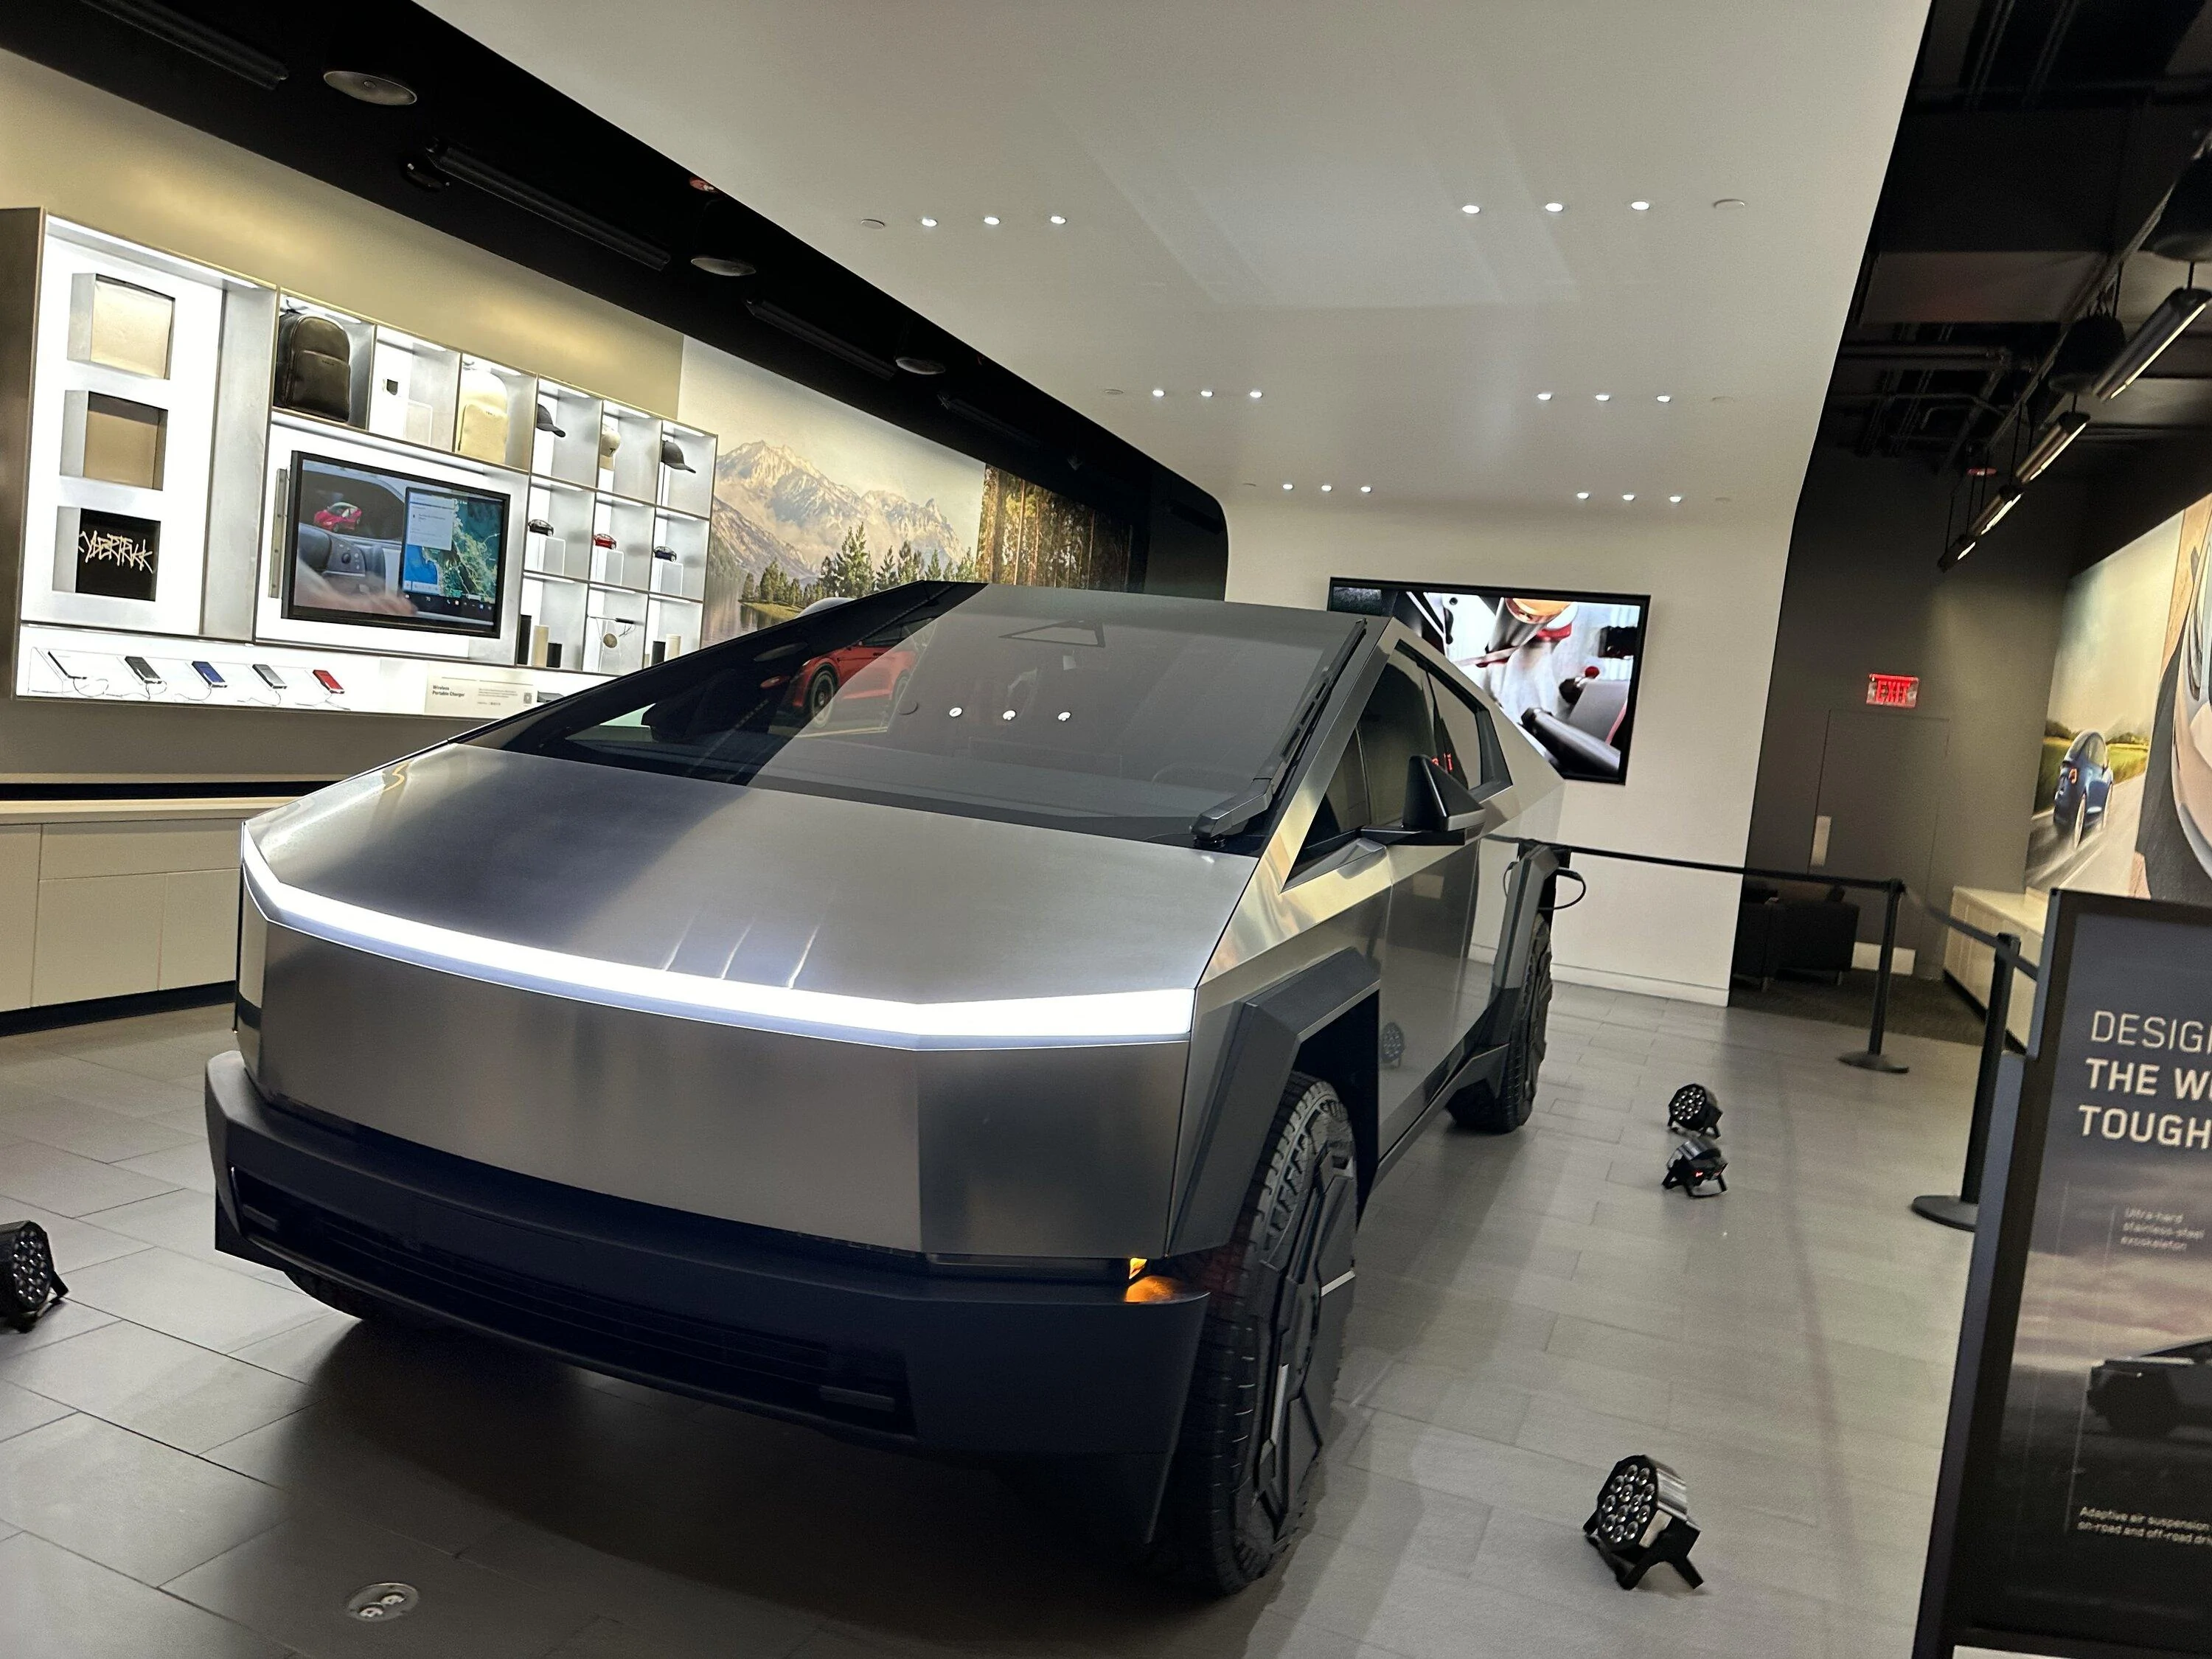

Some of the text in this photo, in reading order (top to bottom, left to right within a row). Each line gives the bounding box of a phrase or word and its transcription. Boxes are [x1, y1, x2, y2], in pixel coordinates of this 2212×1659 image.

[1876, 681, 1910, 703] EXIT
[2085, 1057, 2212, 1101] THE W
[2079, 1506, 2128, 1521] Adaptive
[2124, 1526, 2145, 1538] and
